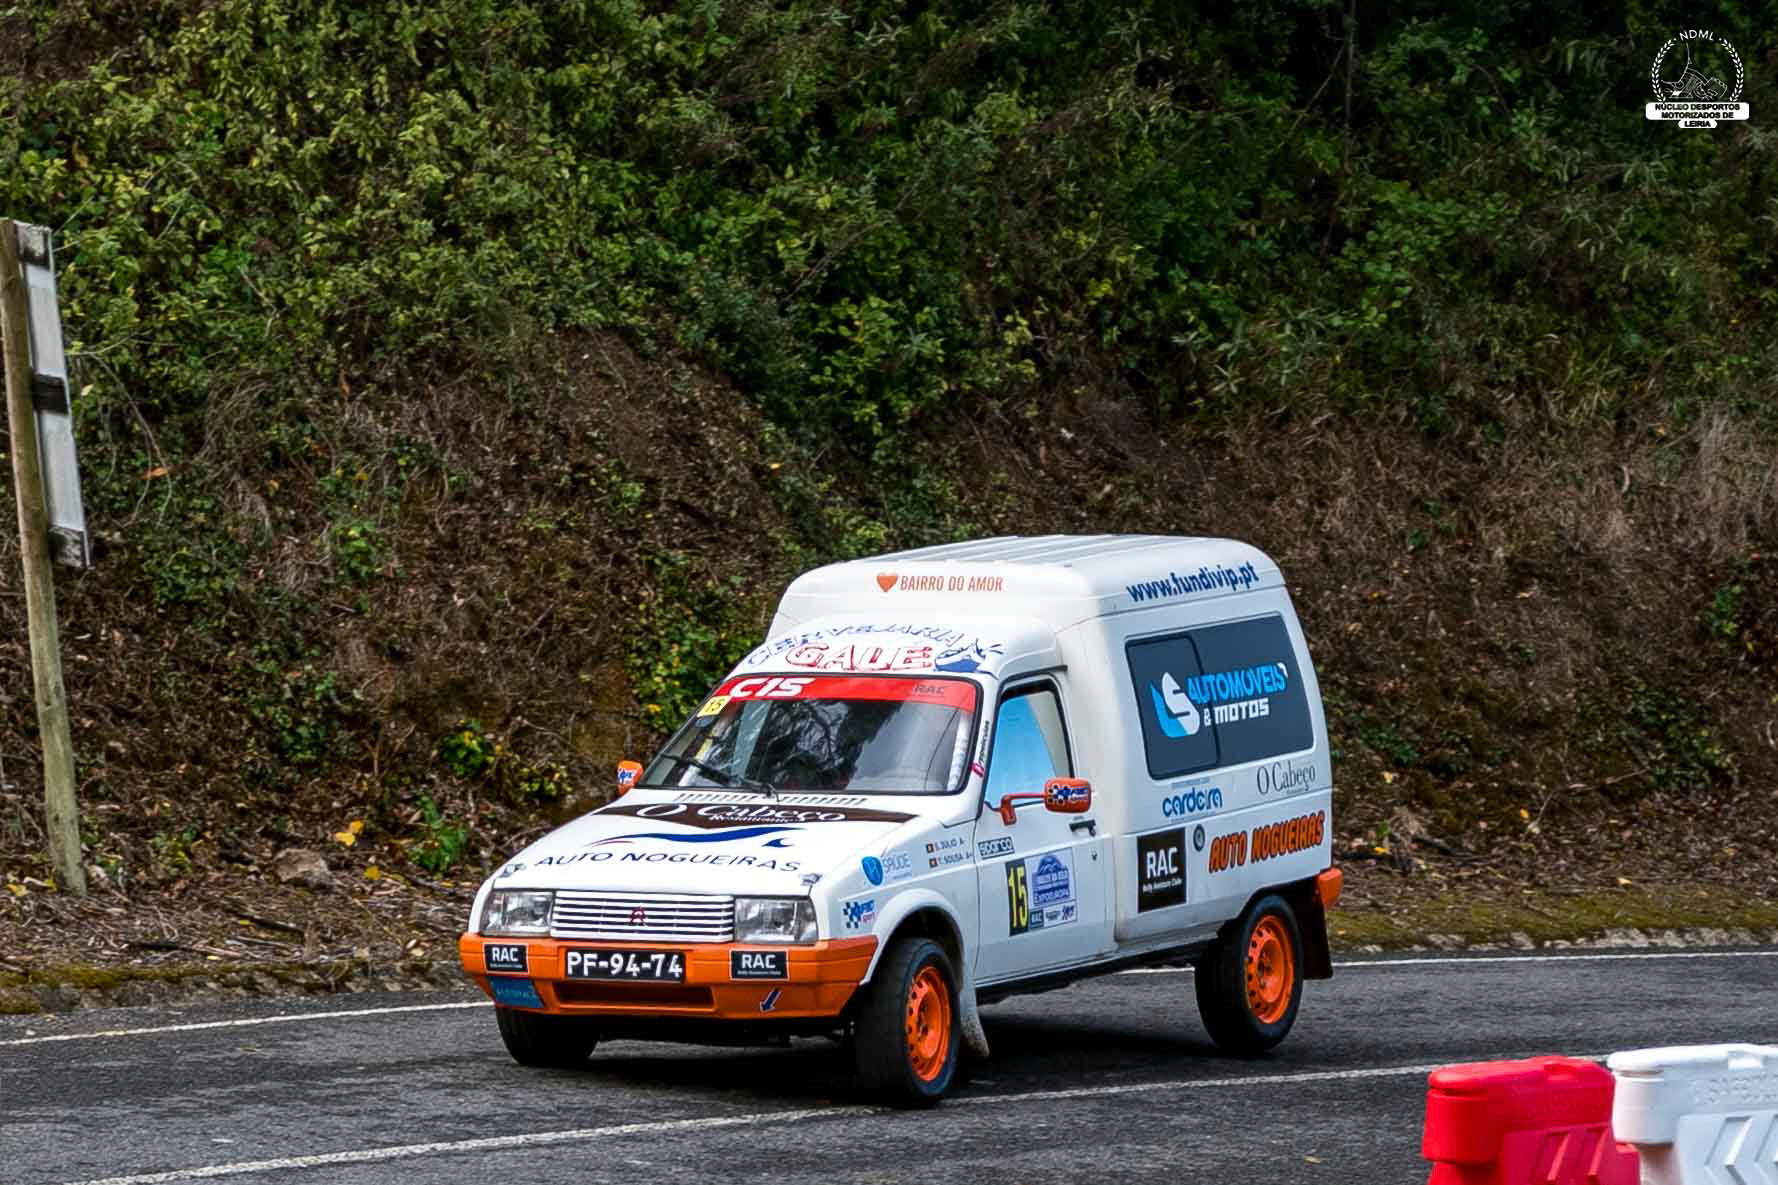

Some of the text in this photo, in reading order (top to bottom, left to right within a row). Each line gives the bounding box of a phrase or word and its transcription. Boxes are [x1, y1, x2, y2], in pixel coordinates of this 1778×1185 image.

[900, 575, 1003, 592] BAIRRO DO AMOR
[1126, 561, 1260, 603] www.fundivip.pt
[730, 677, 816, 697] CIS
[1203, 697, 1270, 726] & MOTOS
[1256, 759, 1316, 795] O Cabeço
[636, 803, 846, 822] O Cabeço
[1207, 808, 1326, 874] AUTO NOGUEIRAS
[535, 850, 801, 873] AUTO NOGUEIRAS
[1145, 846, 1179, 880] RAC
[1008, 865, 1028, 928] 15
[492, 947, 519, 962] RAC
[566, 951, 683, 977] PF-94-74
[742, 953, 776, 969] RAC
